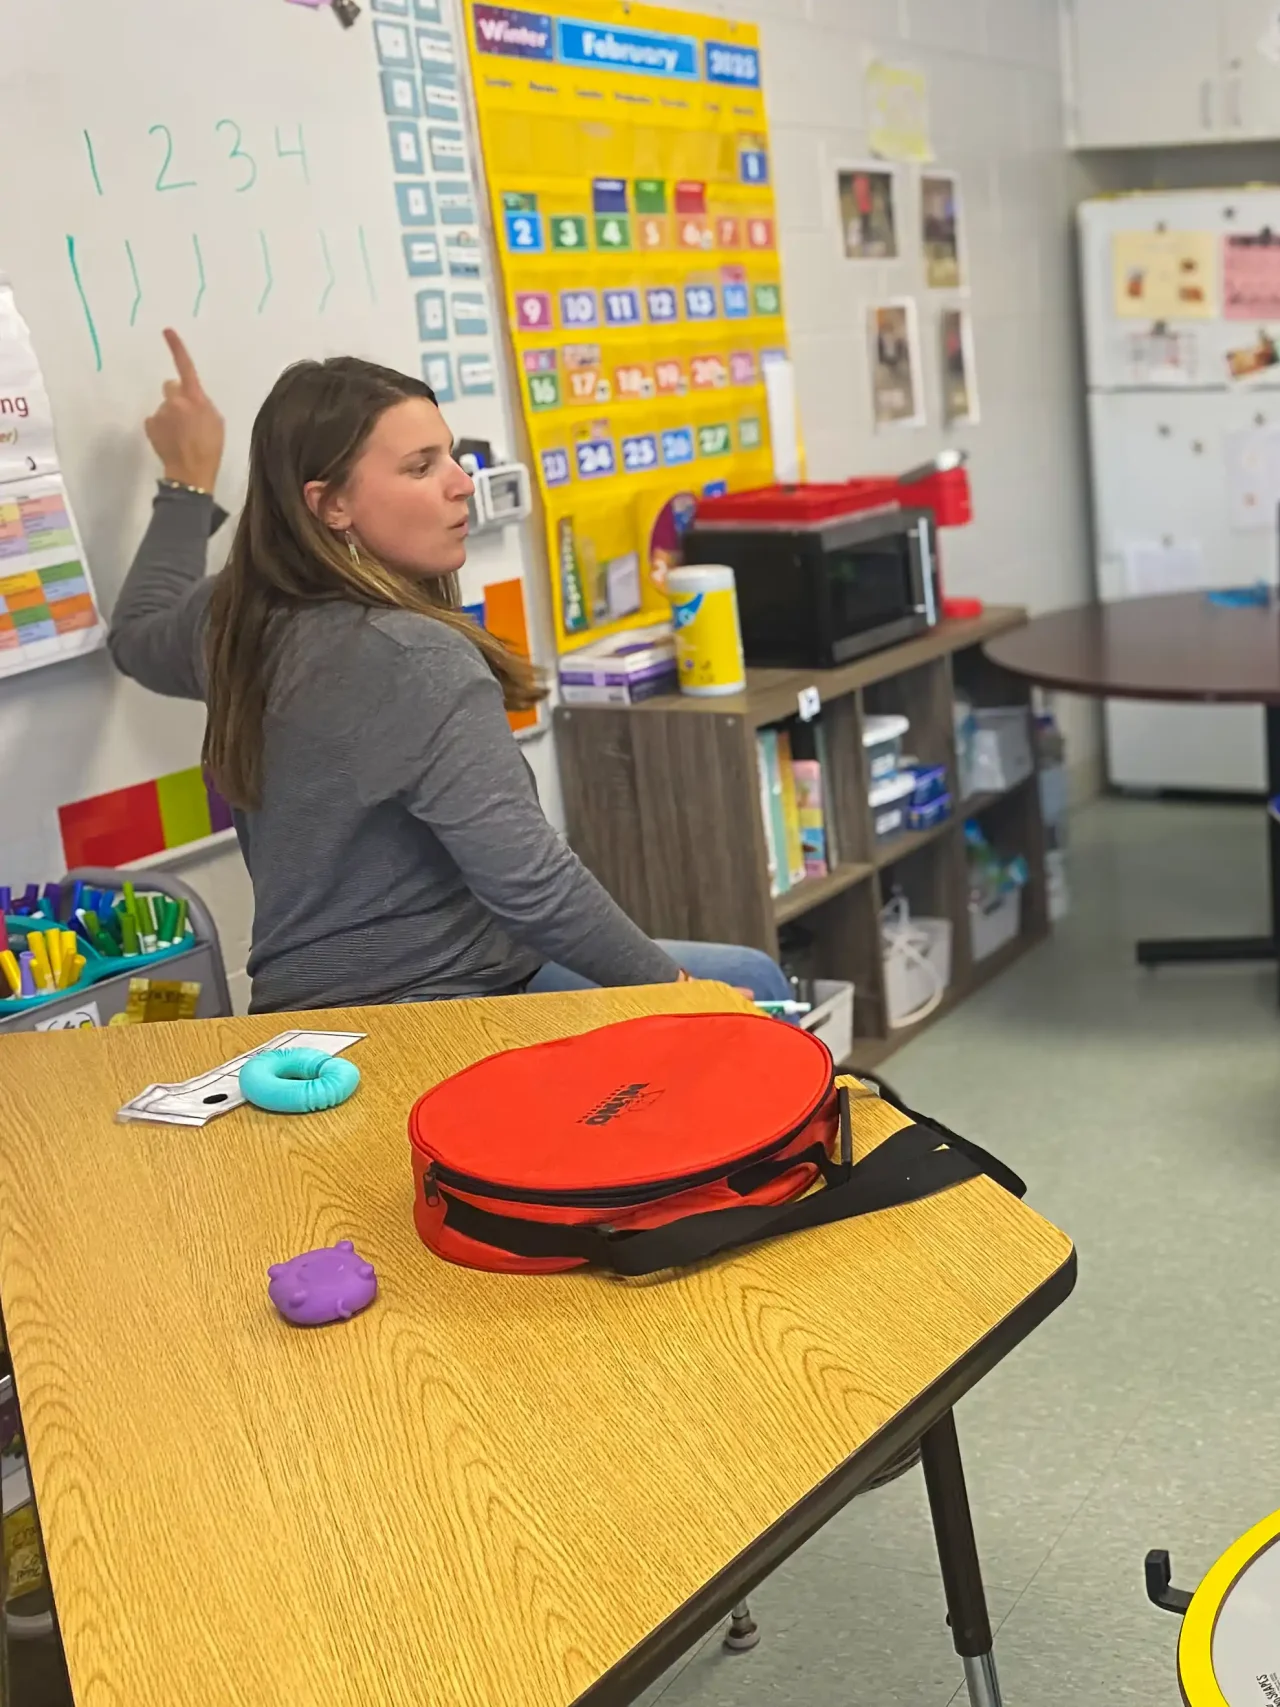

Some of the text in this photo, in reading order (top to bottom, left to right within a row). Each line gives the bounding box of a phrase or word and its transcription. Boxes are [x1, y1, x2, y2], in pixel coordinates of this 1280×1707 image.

[478, 18, 548, 49] Winter
[582, 31, 679, 72] February
[84, 119, 310, 196] 1 2 3 4
[513, 218, 534, 246] 2
[560, 219, 578, 246] 3
[602, 220, 622, 245] 4
[523, 297, 542, 325] 9
[565, 295, 594, 322] 10
[607, 294, 633, 320] 11
[648, 290, 673, 317] 12
[687, 288, 713, 316] 13
[530, 376, 557, 404] 16
[570, 370, 597, 397] 17
[577, 443, 611, 472] 24
[623, 438, 654, 467] 25
[701, 426, 730, 454] 27
